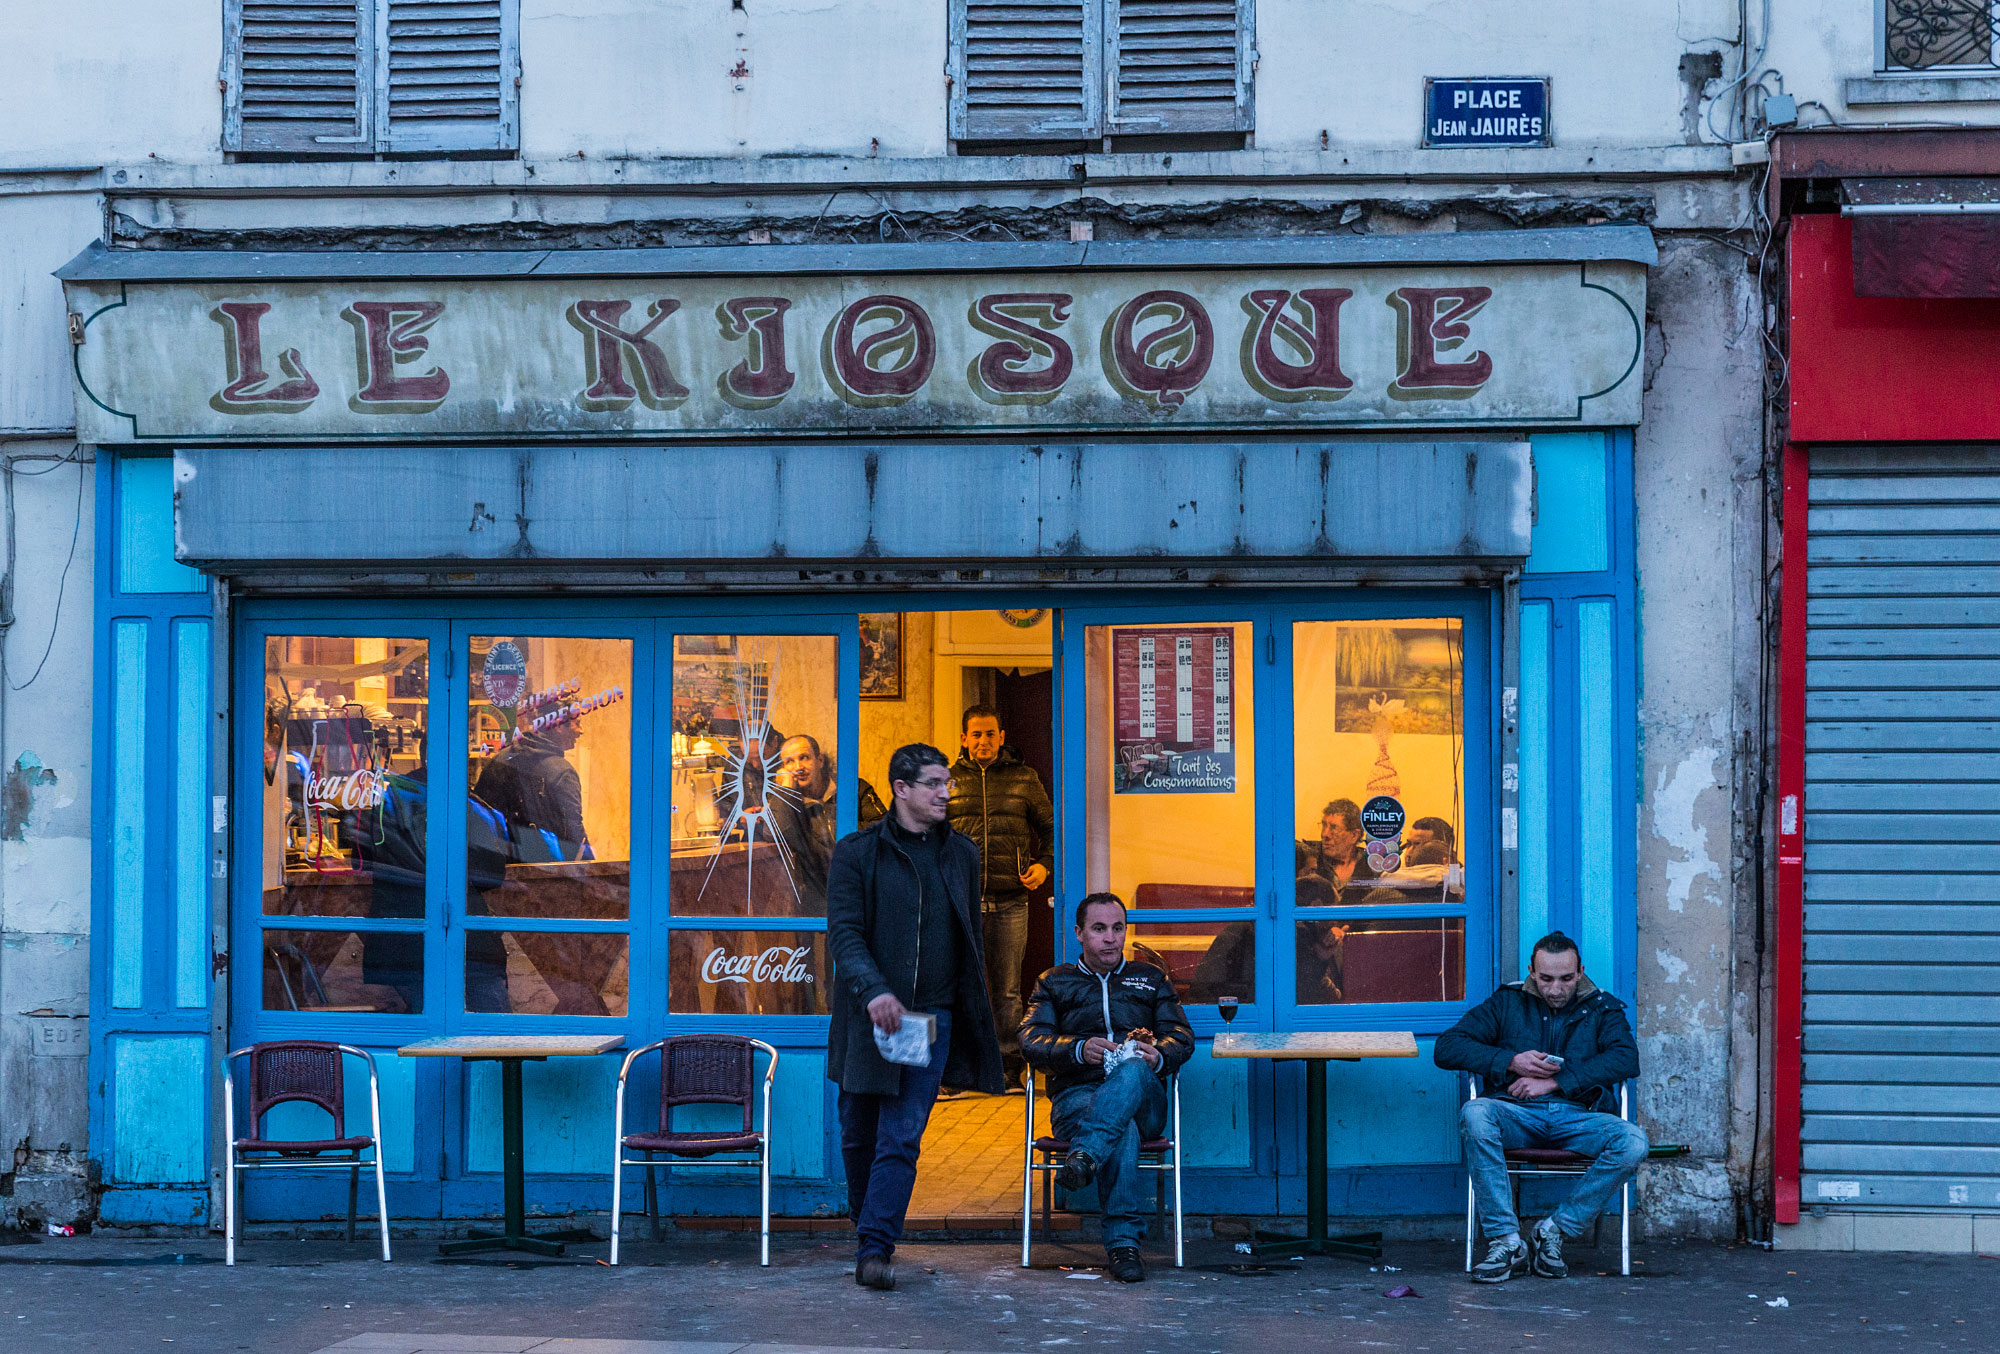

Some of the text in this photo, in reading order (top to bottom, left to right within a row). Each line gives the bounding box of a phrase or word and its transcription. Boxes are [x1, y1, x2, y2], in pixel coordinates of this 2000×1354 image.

[1453, 89, 1522, 109] PLACE
[1470, 112, 1543, 137] JAURÈS
[209, 285, 1493, 416] LE KIOSQUE
[491, 663, 517, 671] LICENCE
[532, 683, 625, 735] PRESSION
[1172, 755, 1201, 776] Tarif
[1143, 770, 1232, 791] Consommations
[43, 1027, 82, 1043] EDF
